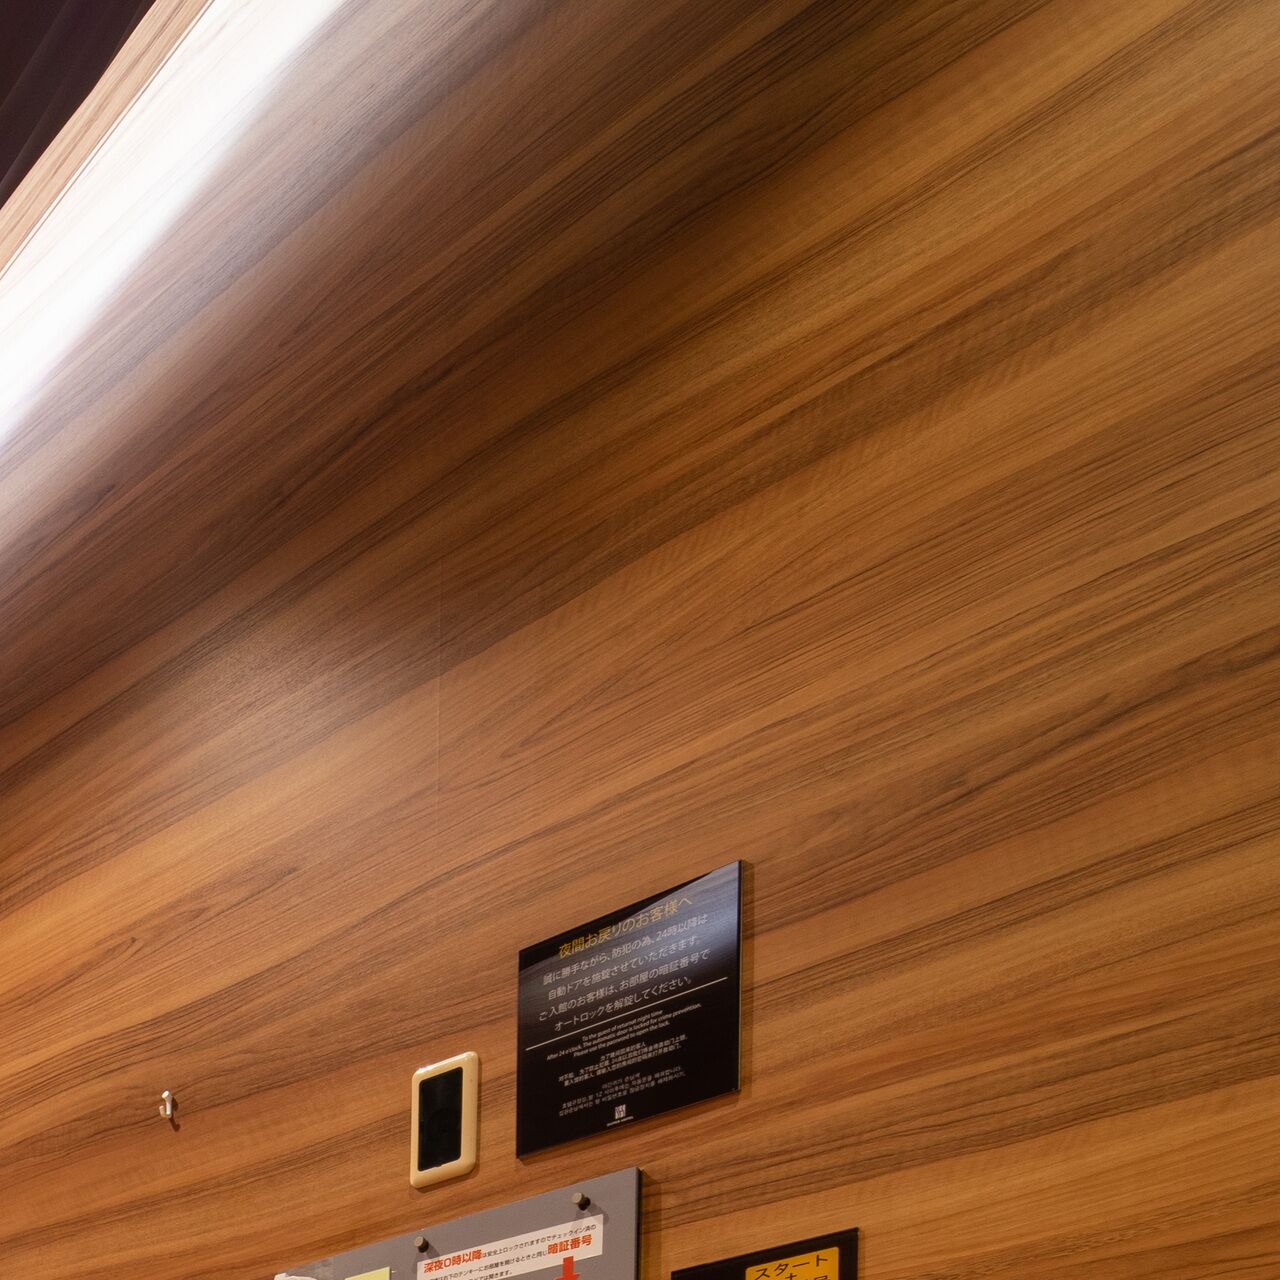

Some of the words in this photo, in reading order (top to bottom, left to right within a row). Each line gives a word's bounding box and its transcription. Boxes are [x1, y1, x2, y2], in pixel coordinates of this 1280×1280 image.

[559, 895, 692, 959] 夜間お戻りのお客様へ
[554, 973, 691, 1032] オートロックを解錠してください。
[754, 1254, 828, 1280] スタート
